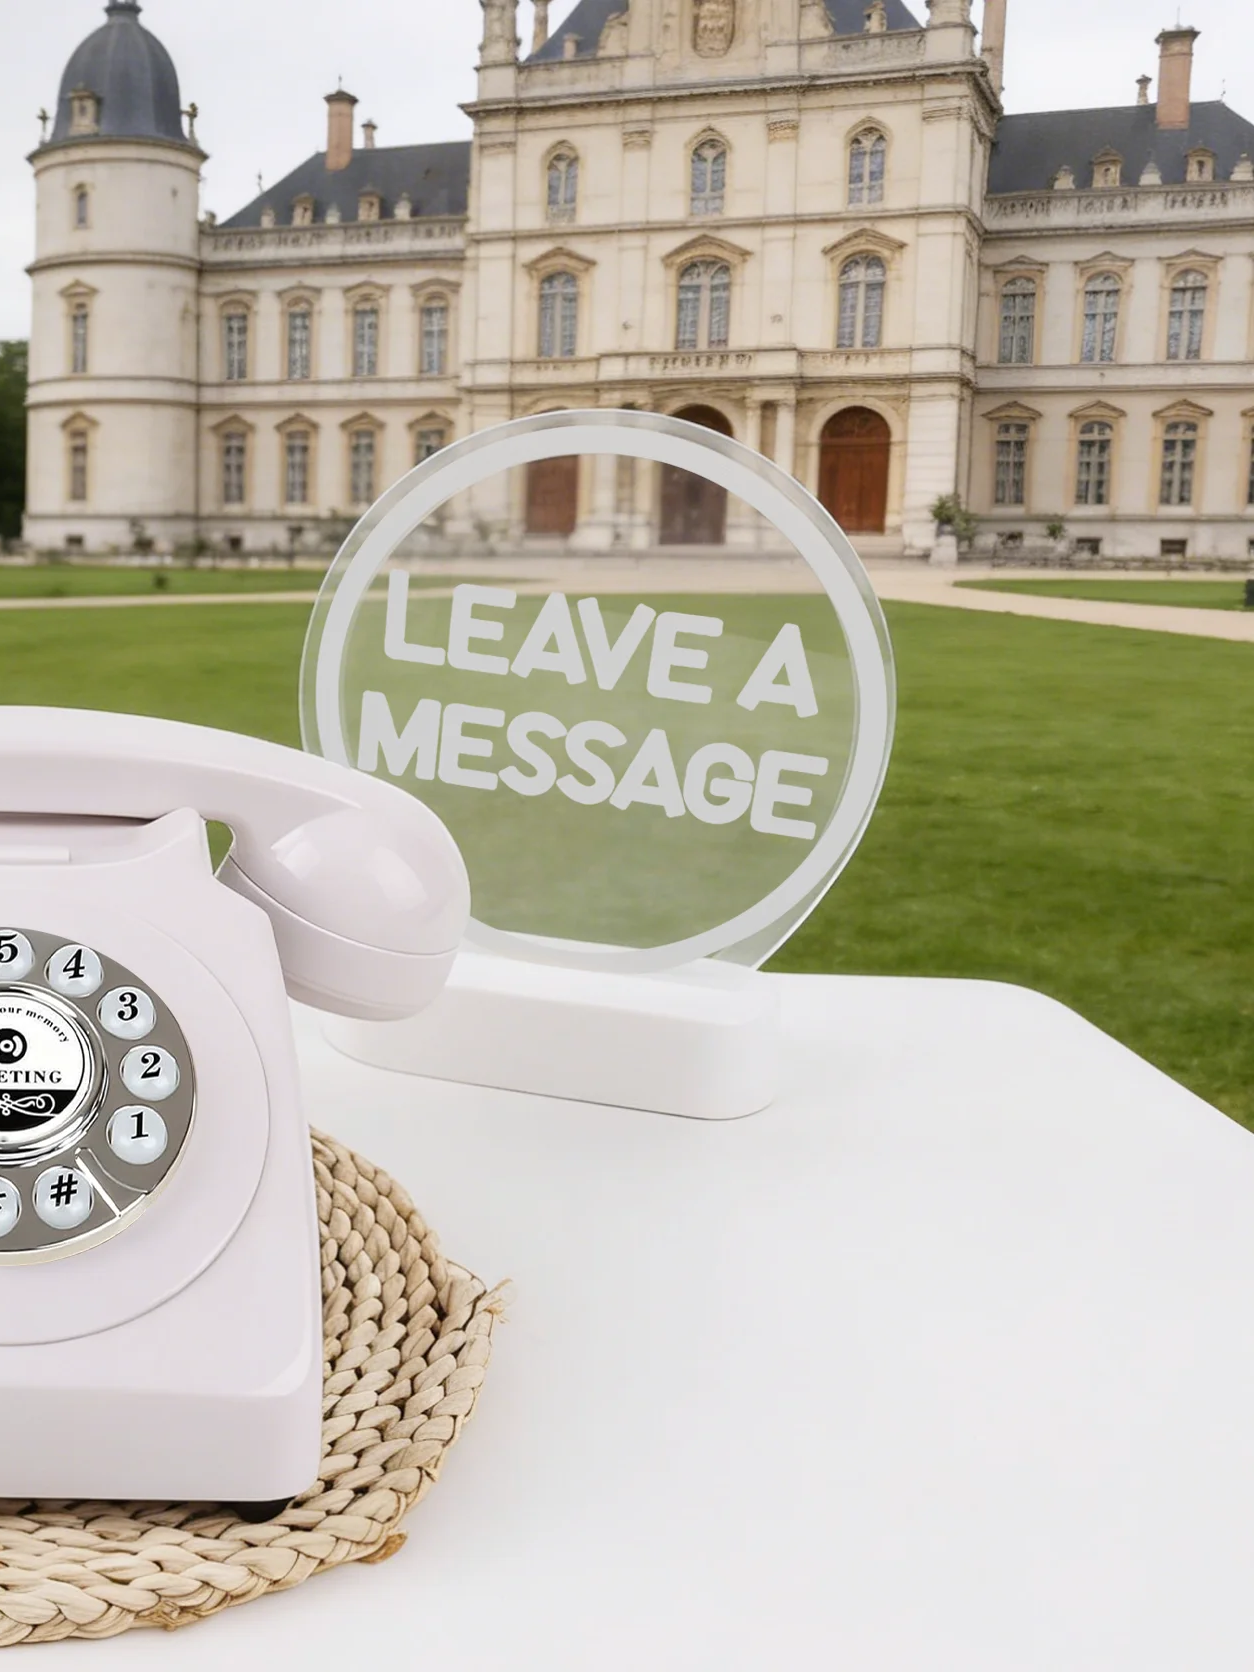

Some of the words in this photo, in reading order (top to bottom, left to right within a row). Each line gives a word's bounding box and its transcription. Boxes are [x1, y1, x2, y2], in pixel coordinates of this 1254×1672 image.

[384, 569, 723, 704] LEAVE
[736, 623, 818, 718] A
[357, 690, 829, 840] MESSAGE
[62, 949, 85, 979] 4
[117, 992, 139, 1021] 3
[25, 1009, 70, 1043] memory
[140, 1052, 162, 1079] 2
[129, 1111, 150, 1140] 1
[49, 1173, 78, 1207] #
